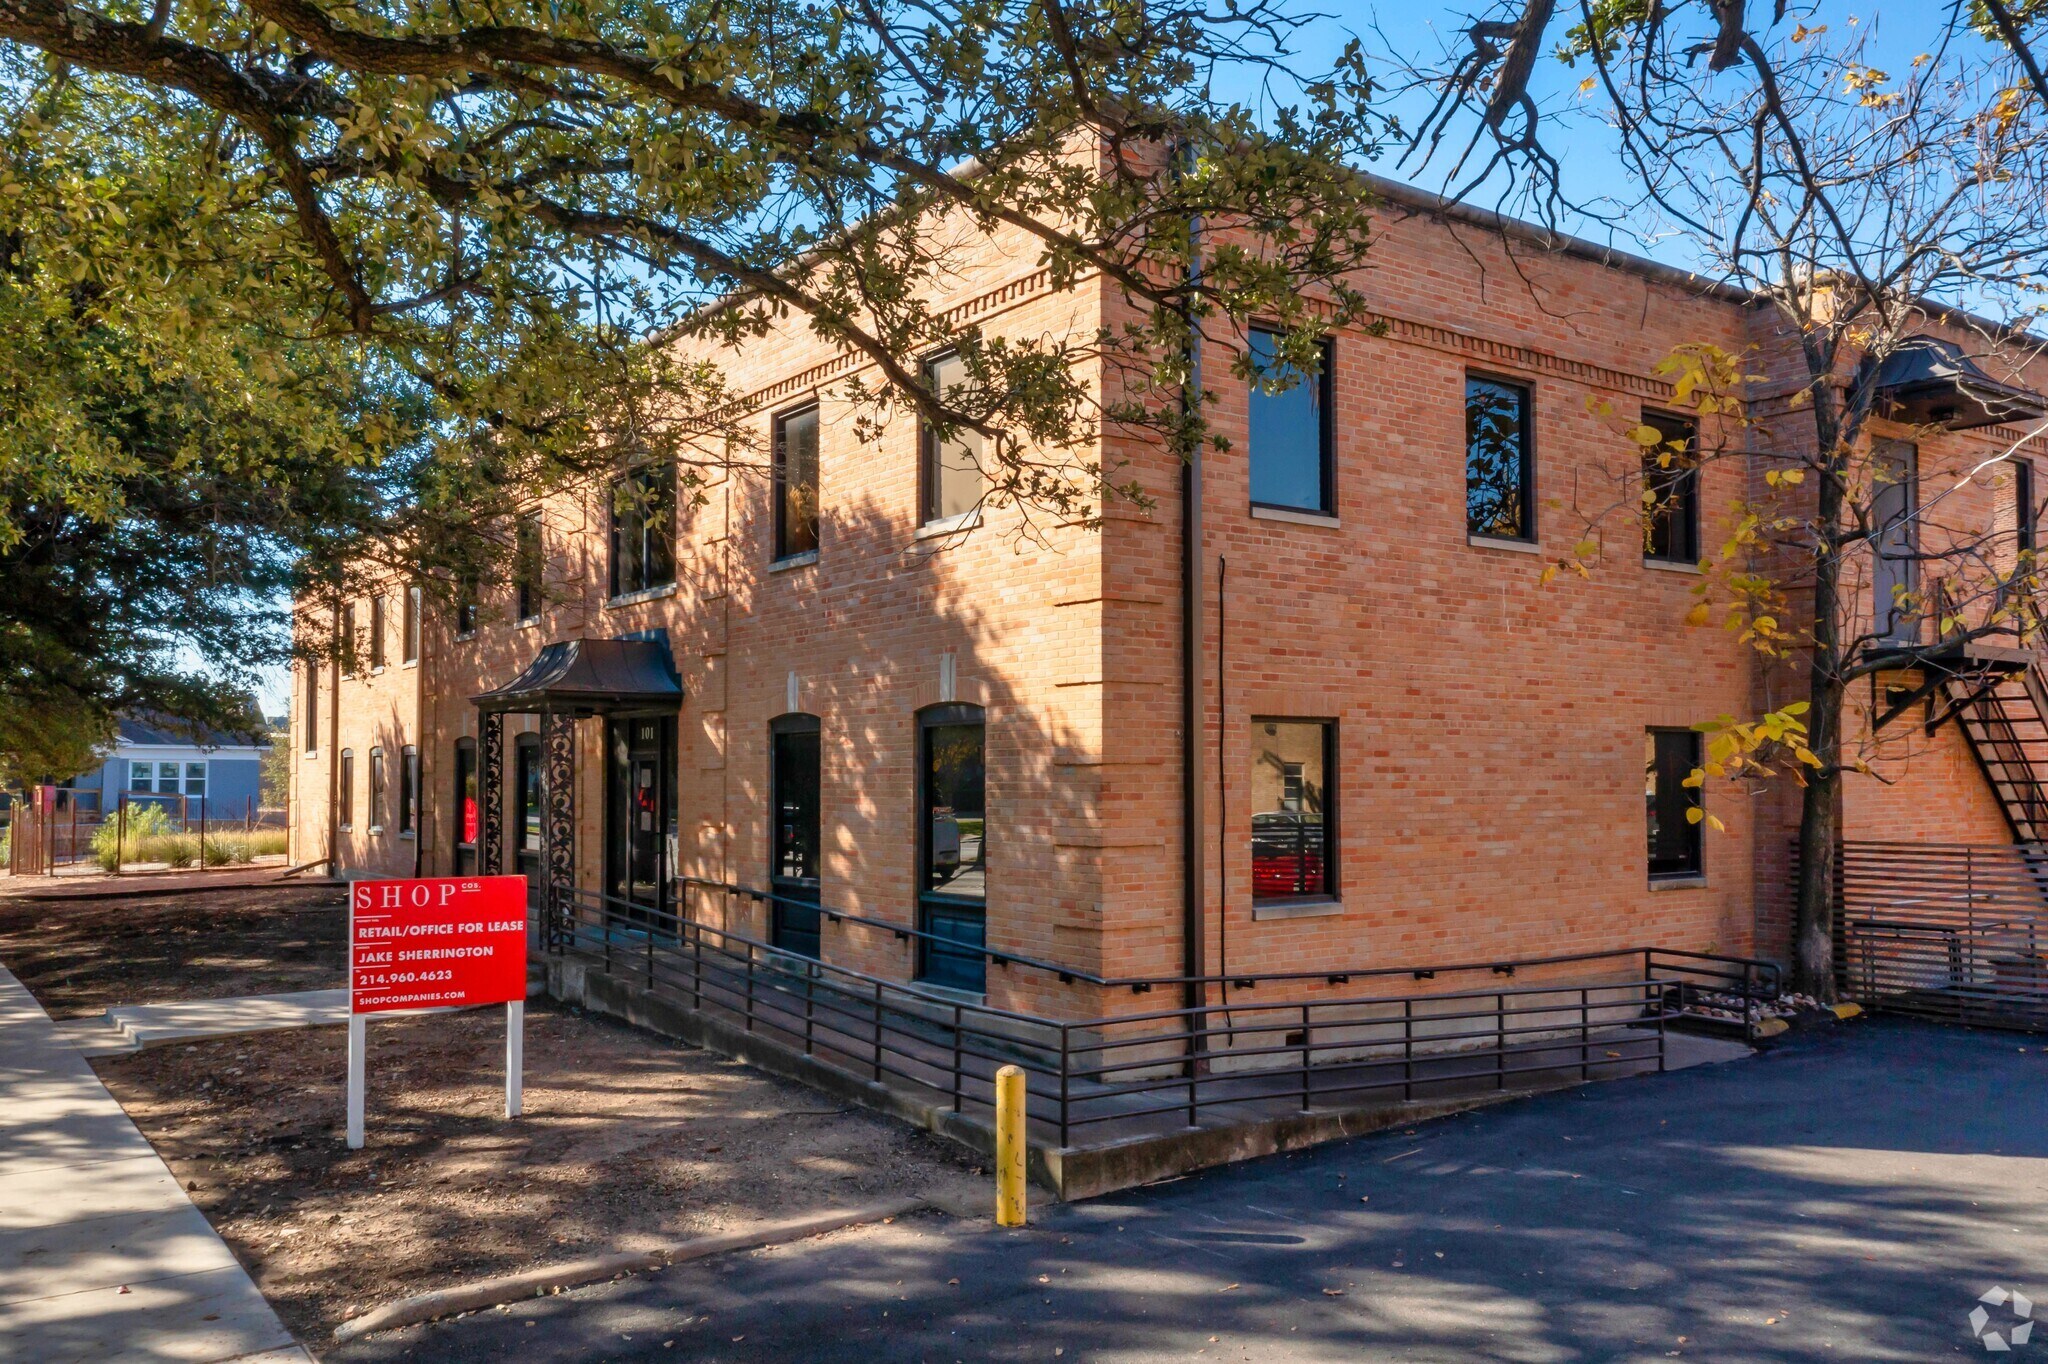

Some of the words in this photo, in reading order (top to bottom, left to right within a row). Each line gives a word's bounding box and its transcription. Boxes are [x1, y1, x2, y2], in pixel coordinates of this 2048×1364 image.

[641, 727, 654, 740] 101
[356, 884, 456, 909] SHOP
[358, 923, 453, 939] RETAIL/OFFICE
[458, 922, 484, 934] FOR
[487, 920, 524, 932] LEASE
[358, 951, 393, 964] JAKE
[398, 946, 494, 961] SHERRINGTON
[359, 970, 453, 985] 214.960.4623
[359, 991, 465, 1005] SHOPCOMPANIES.COM
